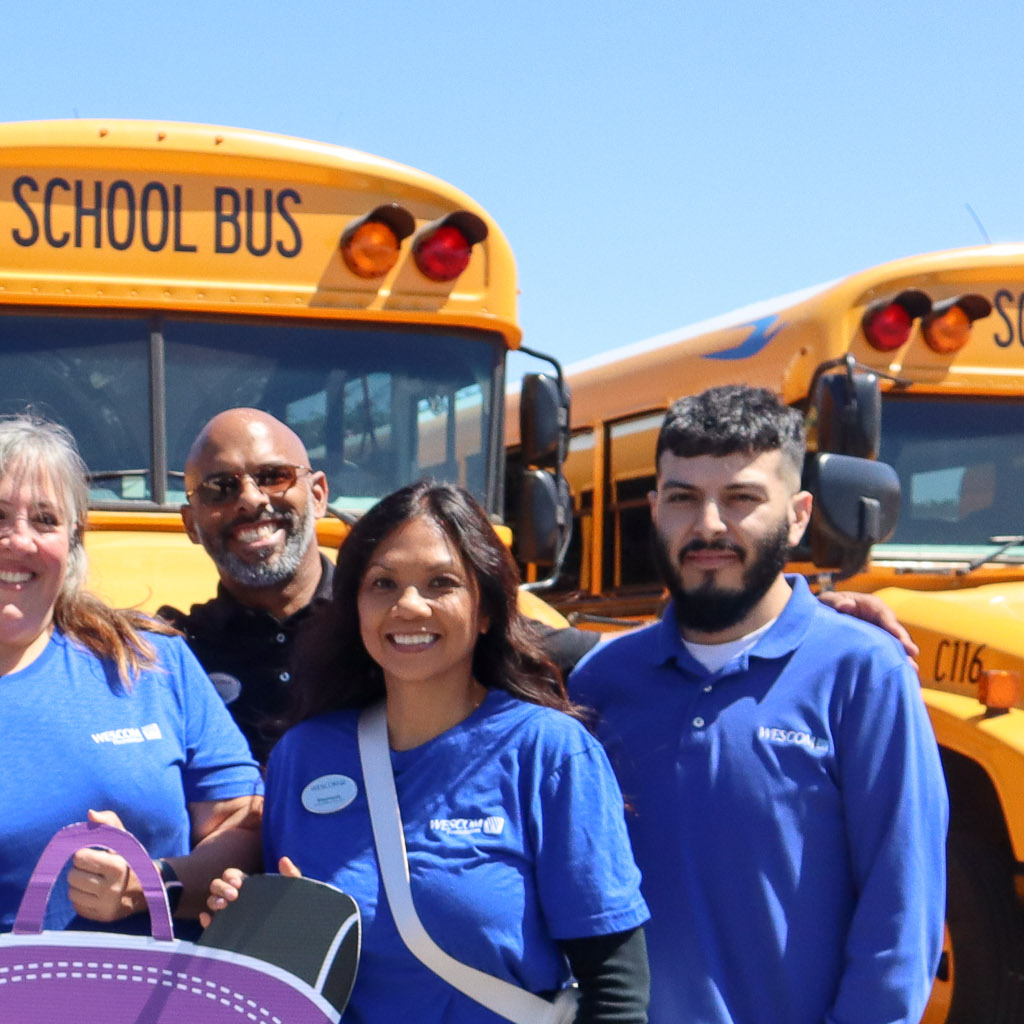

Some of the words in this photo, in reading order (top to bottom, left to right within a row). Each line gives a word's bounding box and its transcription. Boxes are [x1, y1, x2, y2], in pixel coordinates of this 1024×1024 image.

[11, 175, 198, 252] SCHOOL
[214, 186, 302, 258] BUS
[994, 289, 1024, 348] S
[934, 639, 987, 684] C116
[91, 728, 142, 744] WESCOM
